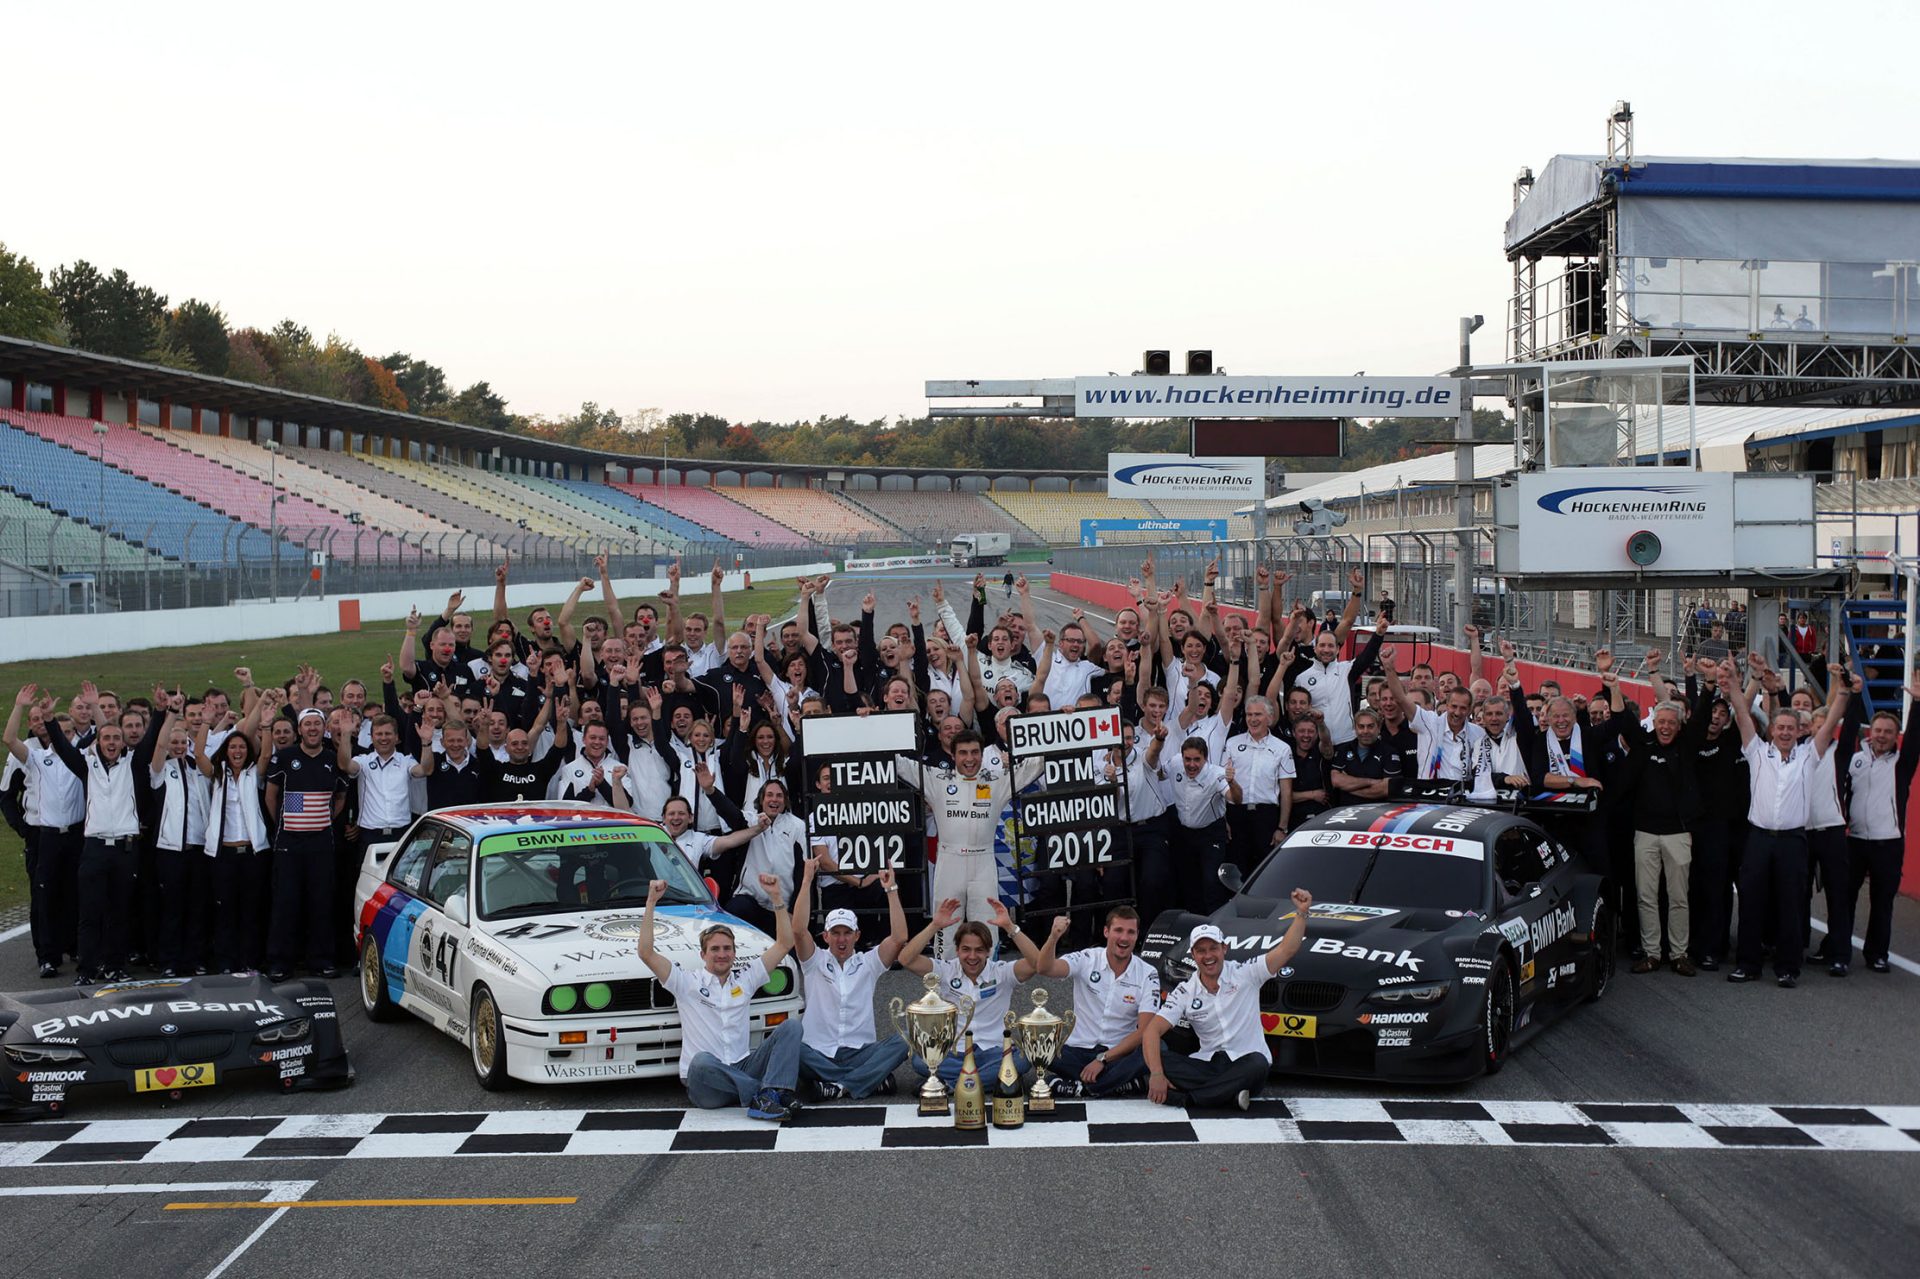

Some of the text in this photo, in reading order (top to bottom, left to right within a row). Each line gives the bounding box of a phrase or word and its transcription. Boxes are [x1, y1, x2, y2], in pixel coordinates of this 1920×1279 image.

[1085, 385, 1451, 409] www.hockenheimring.de
[1137, 520, 1181, 530] ultimate
[316, 553, 321, 563] 1
[1012, 717, 1086, 749] BRUNO
[502, 773, 536, 784] BRUNO
[831, 760, 896, 786] TEAM
[1045, 756, 1093, 785] DTM
[816, 800, 911, 827] CHAMPIONS
[946, 810, 990, 819] BMW Bank
[1024, 794, 1116, 827] CHAMPION
[517, 830, 638, 848] BMW M Team
[1348, 834, 1454, 852] BOSCH
[838, 834, 905, 870] 2012
[1047, 828, 1113, 869] 2012
[1320, 904, 1384, 914] DEKRA
[495, 922, 579, 940] 47
[1531, 901, 1577, 952] BMW Bank
[436, 931, 459, 990] 47
[467, 937, 518, 975] Original BMW Teile
[1310, 937, 1425, 973] Bank
[1471, 957, 1493, 966] Driving
[1378, 975, 1416, 986] SONAX
[1462, 976, 1487, 984] EXIDE
[32, 1000, 285, 1039] BMW Bank
[255, 1015, 284, 1027] SONAX
[1377, 1038, 1413, 1047] EDGE
[1387, 1029, 1410, 1038] Castrol
[280, 1066, 306, 1079] EDGE
[286, 1059, 302, 1068] Castrol
[544, 1064, 637, 1078] WARSTEINER
[40, 1084, 63, 1092] Castrol
[146, 1071, 151, 1089] I
[32, 1093, 65, 1102] EDGE
